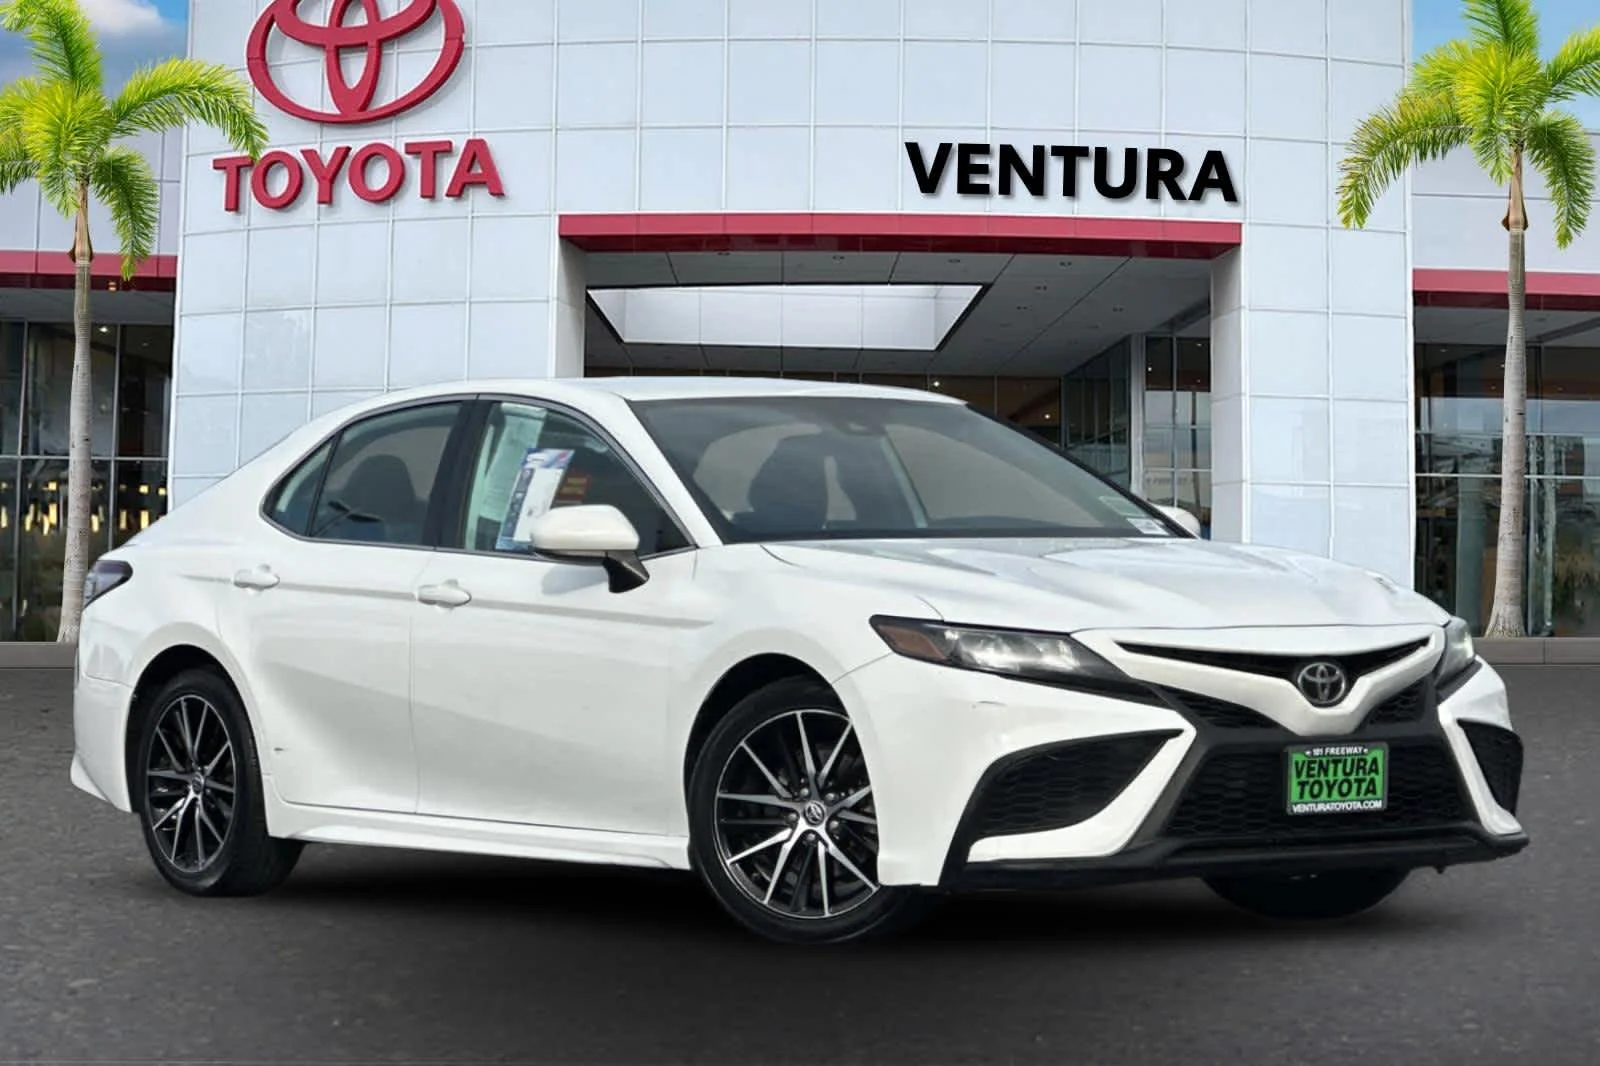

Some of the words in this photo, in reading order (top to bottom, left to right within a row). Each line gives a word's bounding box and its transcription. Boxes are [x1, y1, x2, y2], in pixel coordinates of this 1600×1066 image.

[212, 138, 505, 212] TOYOTA
[904, 141, 1238, 203] VENTURA
[1325, 746, 1363, 755] FREEWAY
[1294, 757, 1379, 779] VENTURA
[1297, 777, 1377, 799] TOYOTA
[1292, 800, 1382, 813] VENTURATOYOTA.COM
